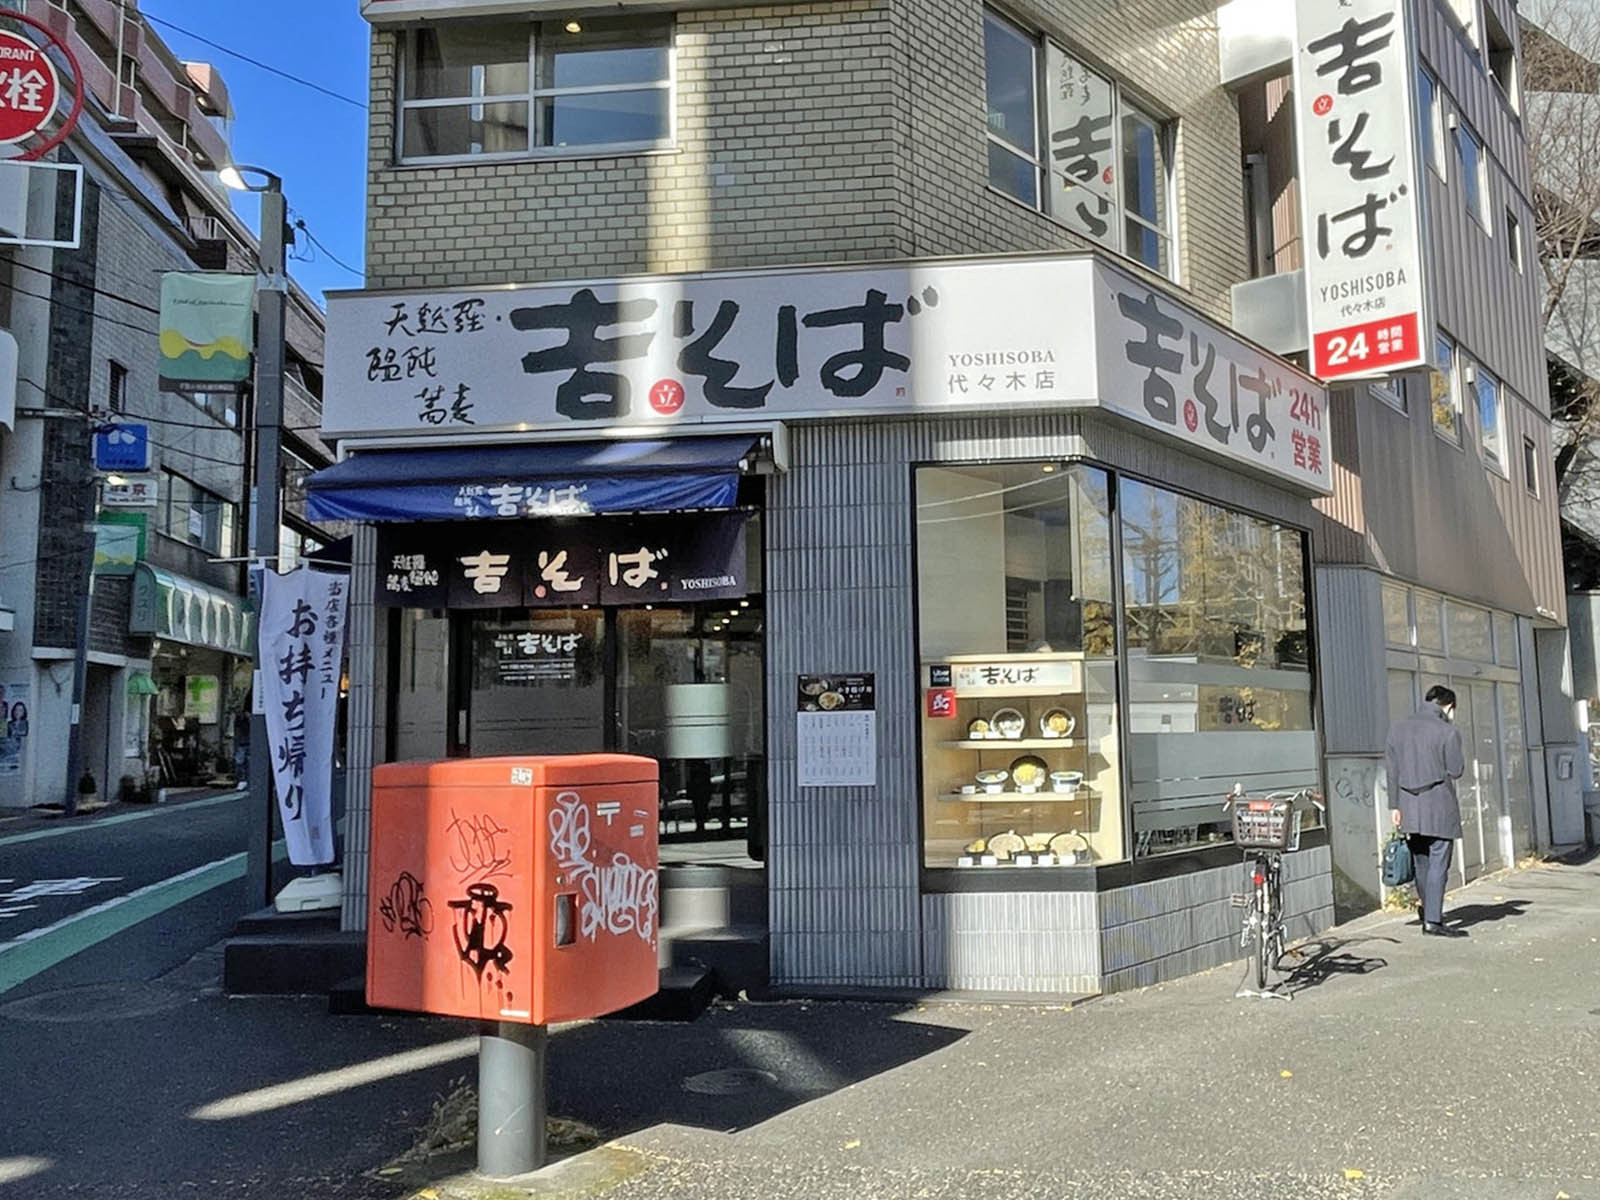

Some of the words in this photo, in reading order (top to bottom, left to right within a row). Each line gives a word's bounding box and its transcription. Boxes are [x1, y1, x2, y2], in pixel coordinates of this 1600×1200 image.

[1307, 11, 1407, 259] 吉そば
[1320, 268, 1406, 302] YOSHISOBA
[1340, 296, 1386, 317] 代々木店
[509, 286, 938, 420] 吉そば
[949, 350, 1055, 367] YOSHISOBA
[1327, 332, 1369, 366] 24
[948, 370, 1055, 394] 代々木店
[1117, 293, 1282, 453] 吉そば
[1289, 388, 1321, 431] 24h
[1291, 427, 1322, 475] 営業
[459, 547, 669, 594] 吉そば
[516, 632, 583, 655] 吉そば
[979, 666, 1040, 685] 吉そば
